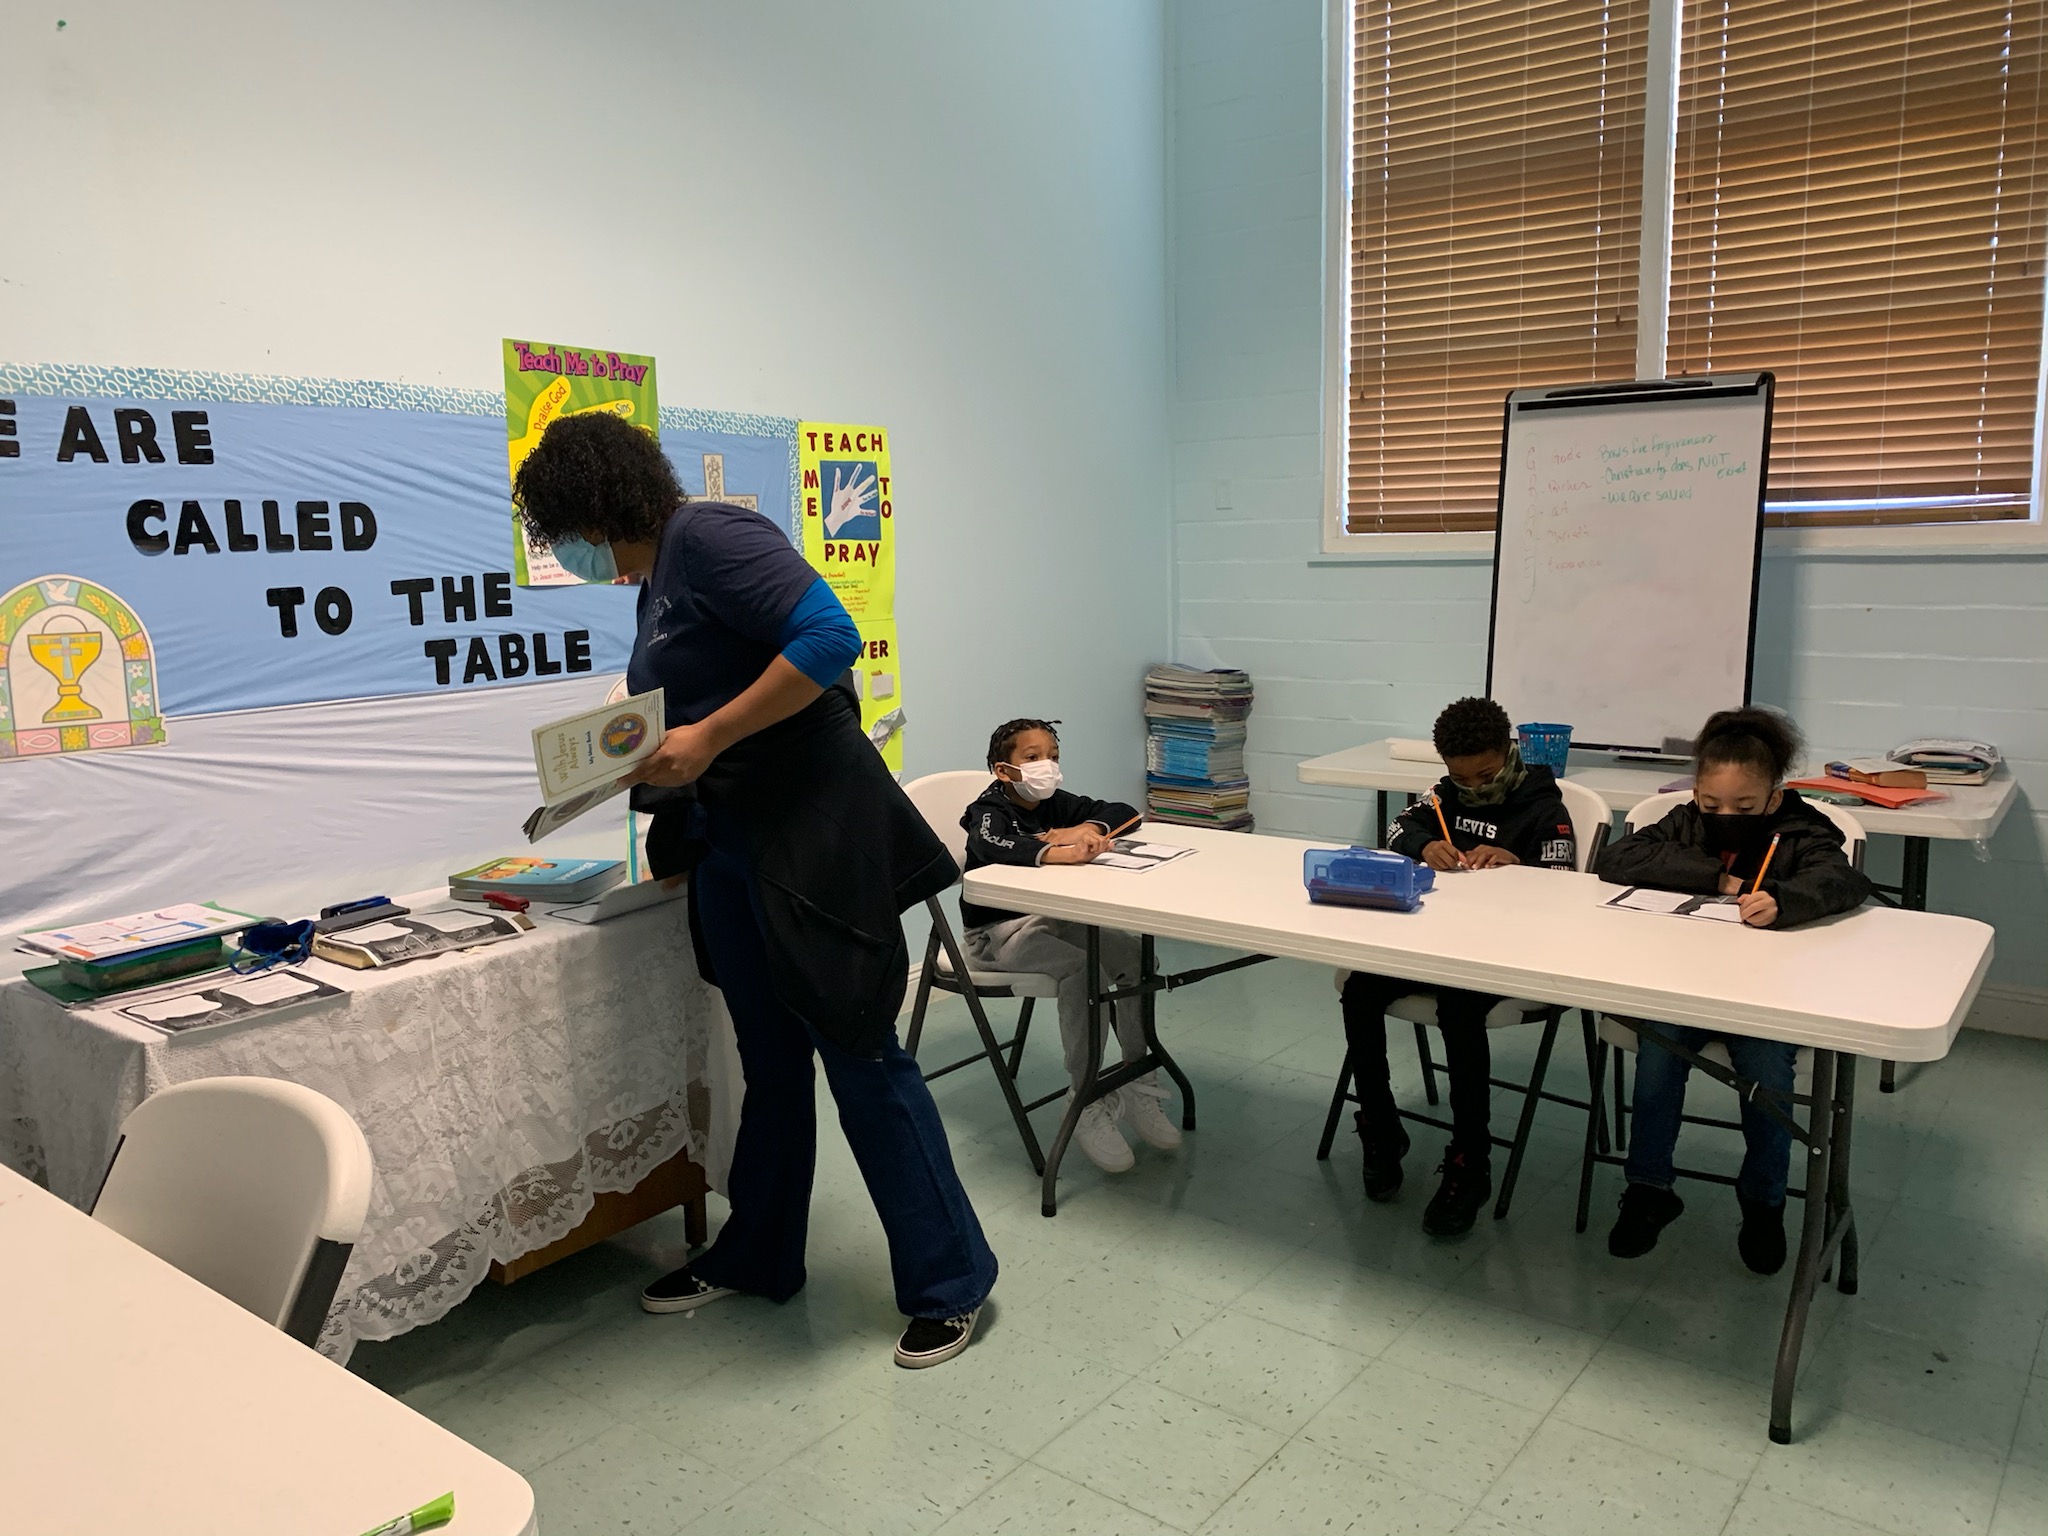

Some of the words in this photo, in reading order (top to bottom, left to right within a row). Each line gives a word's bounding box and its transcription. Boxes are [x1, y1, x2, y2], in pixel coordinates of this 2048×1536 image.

[513, 341, 562, 375] Teach
[564, 350, 589, 376] Me
[590, 353, 608, 377] to
[606, 352, 648, 387] Pray
[533, 401, 553, 431] Praise
[548, 381, 567, 405] God
[615, 402, 632, 415] Sins
[56, 405, 214, 465] ARE
[806, 432, 883, 452] TEACH
[1697, 452, 1730, 471] NOT
[1655, 485, 1693, 501] saved
[126, 499, 378, 556] CALLED
[825, 543, 880, 567] PRAY
[267, 586, 353, 638] TO
[390, 572, 512, 625] THE
[424, 630, 592, 685] TABLE
[552, 732, 569, 760] Jesus
[567, 736, 580, 769] Always
[552, 759, 569, 784] With
[1454, 815, 1498, 840] LEVI'S
